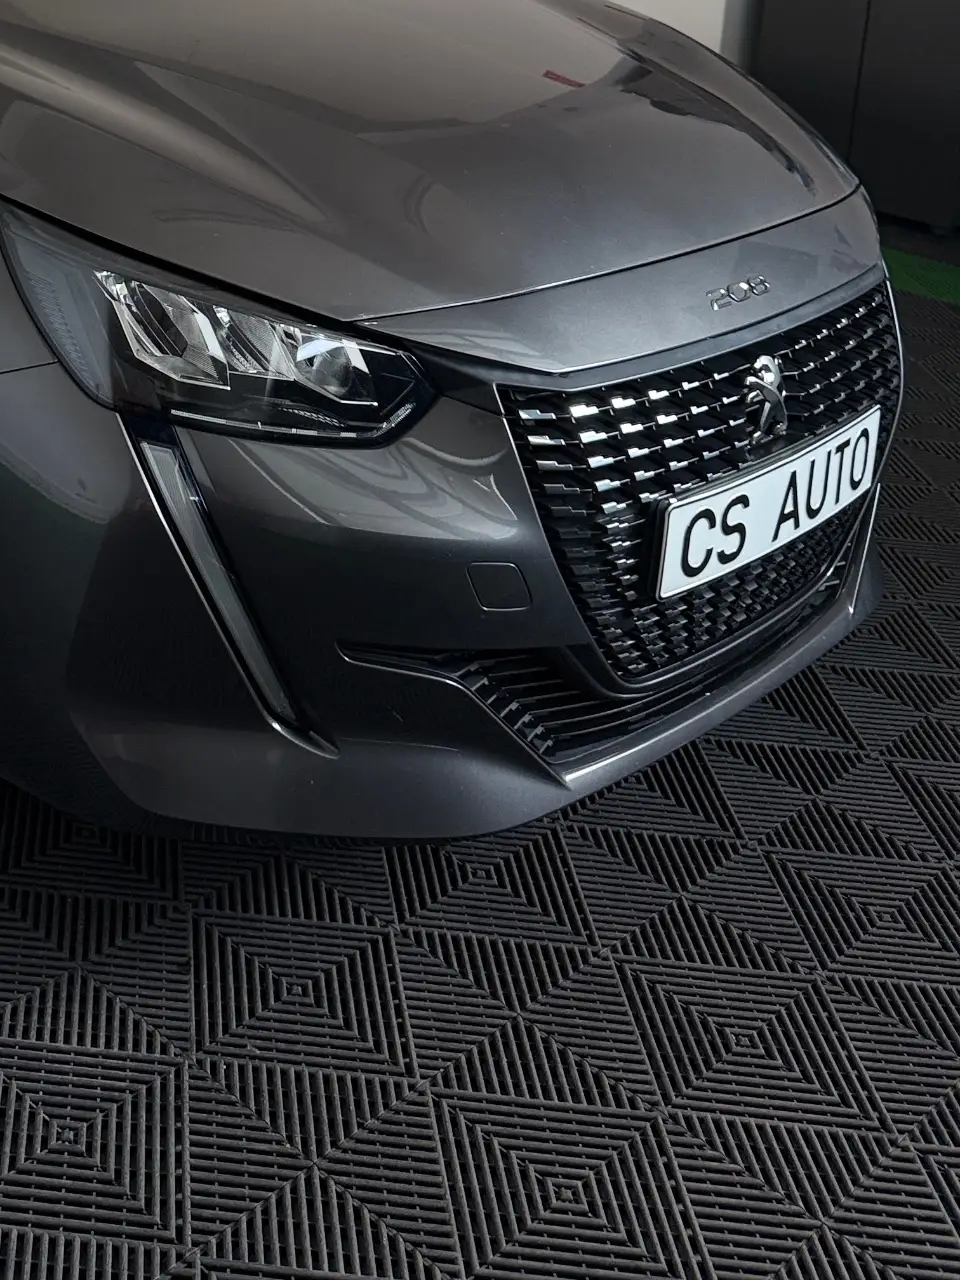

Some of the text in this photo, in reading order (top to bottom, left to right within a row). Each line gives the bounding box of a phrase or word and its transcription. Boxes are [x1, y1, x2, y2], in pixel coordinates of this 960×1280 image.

[706, 275, 771, 311] 208
[681, 427, 869, 577] CS AUTO
